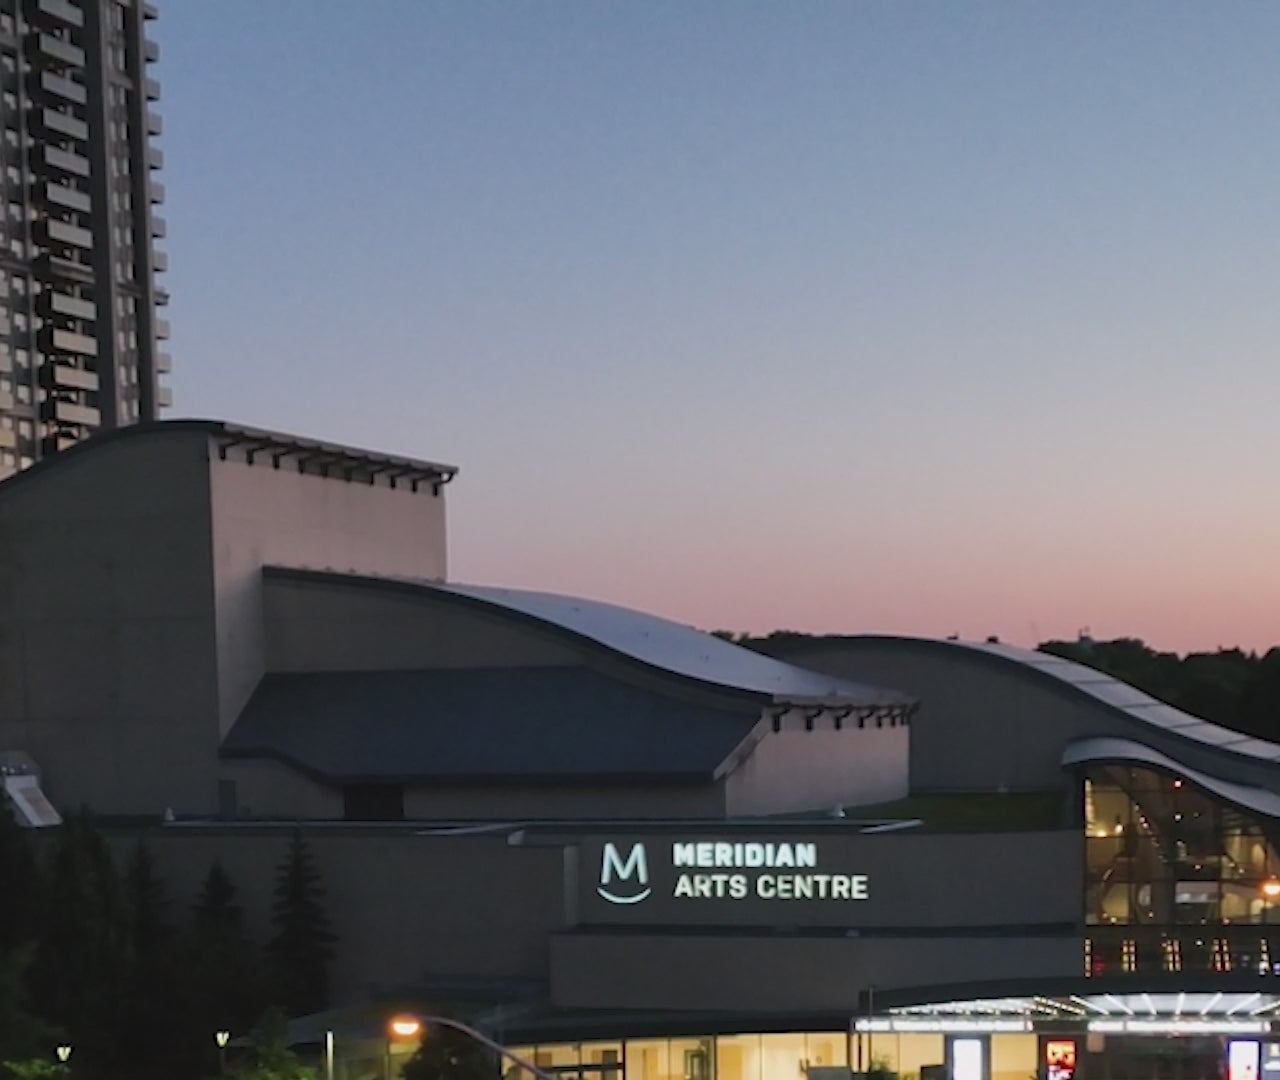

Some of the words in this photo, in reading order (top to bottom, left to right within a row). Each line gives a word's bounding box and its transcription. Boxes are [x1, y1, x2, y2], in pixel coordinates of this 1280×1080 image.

[672, 841, 817, 868] MERIDIAN
[674, 873, 748, 899] ARTS
[756, 874, 869, 900] CENTRE
